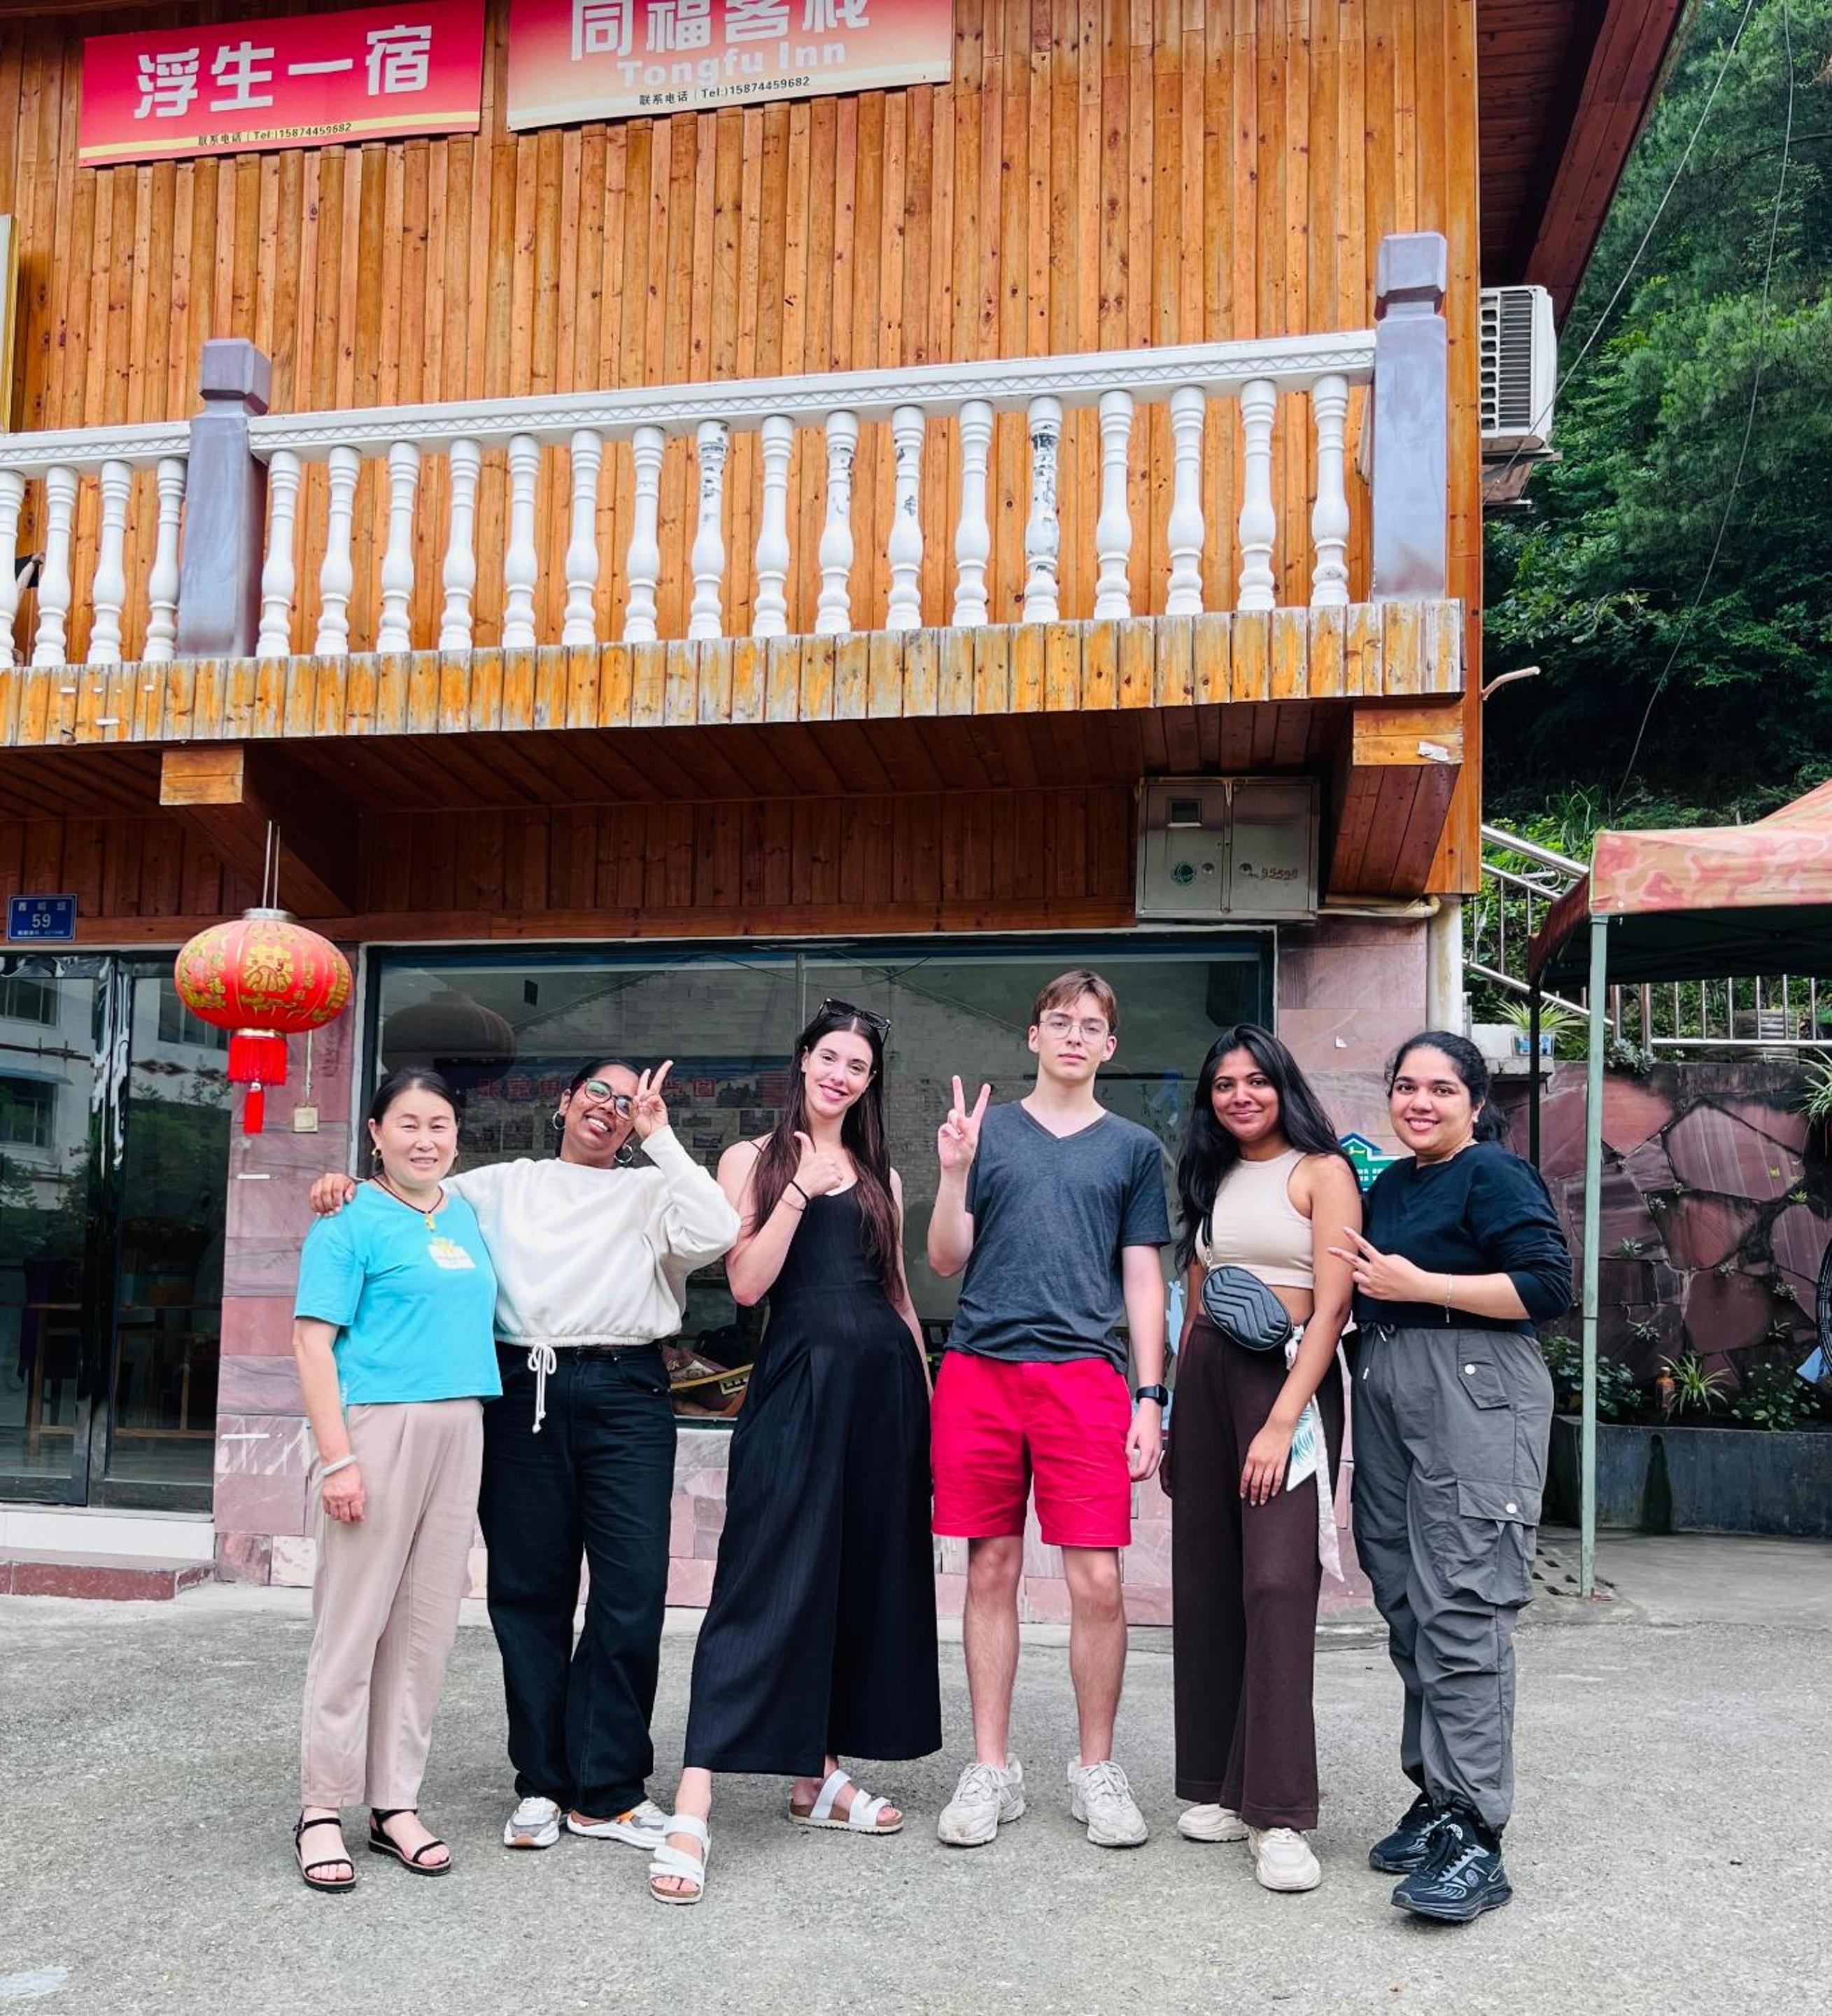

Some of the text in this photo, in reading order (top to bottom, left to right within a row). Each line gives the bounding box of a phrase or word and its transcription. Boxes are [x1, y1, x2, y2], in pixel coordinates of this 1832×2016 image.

[134, 24, 432, 120] 浮生一宿
[616, 41, 846, 87] Tongfu Inn
[639, 91, 688, 106] 联系电话
[32, 913, 51, 928] 59
